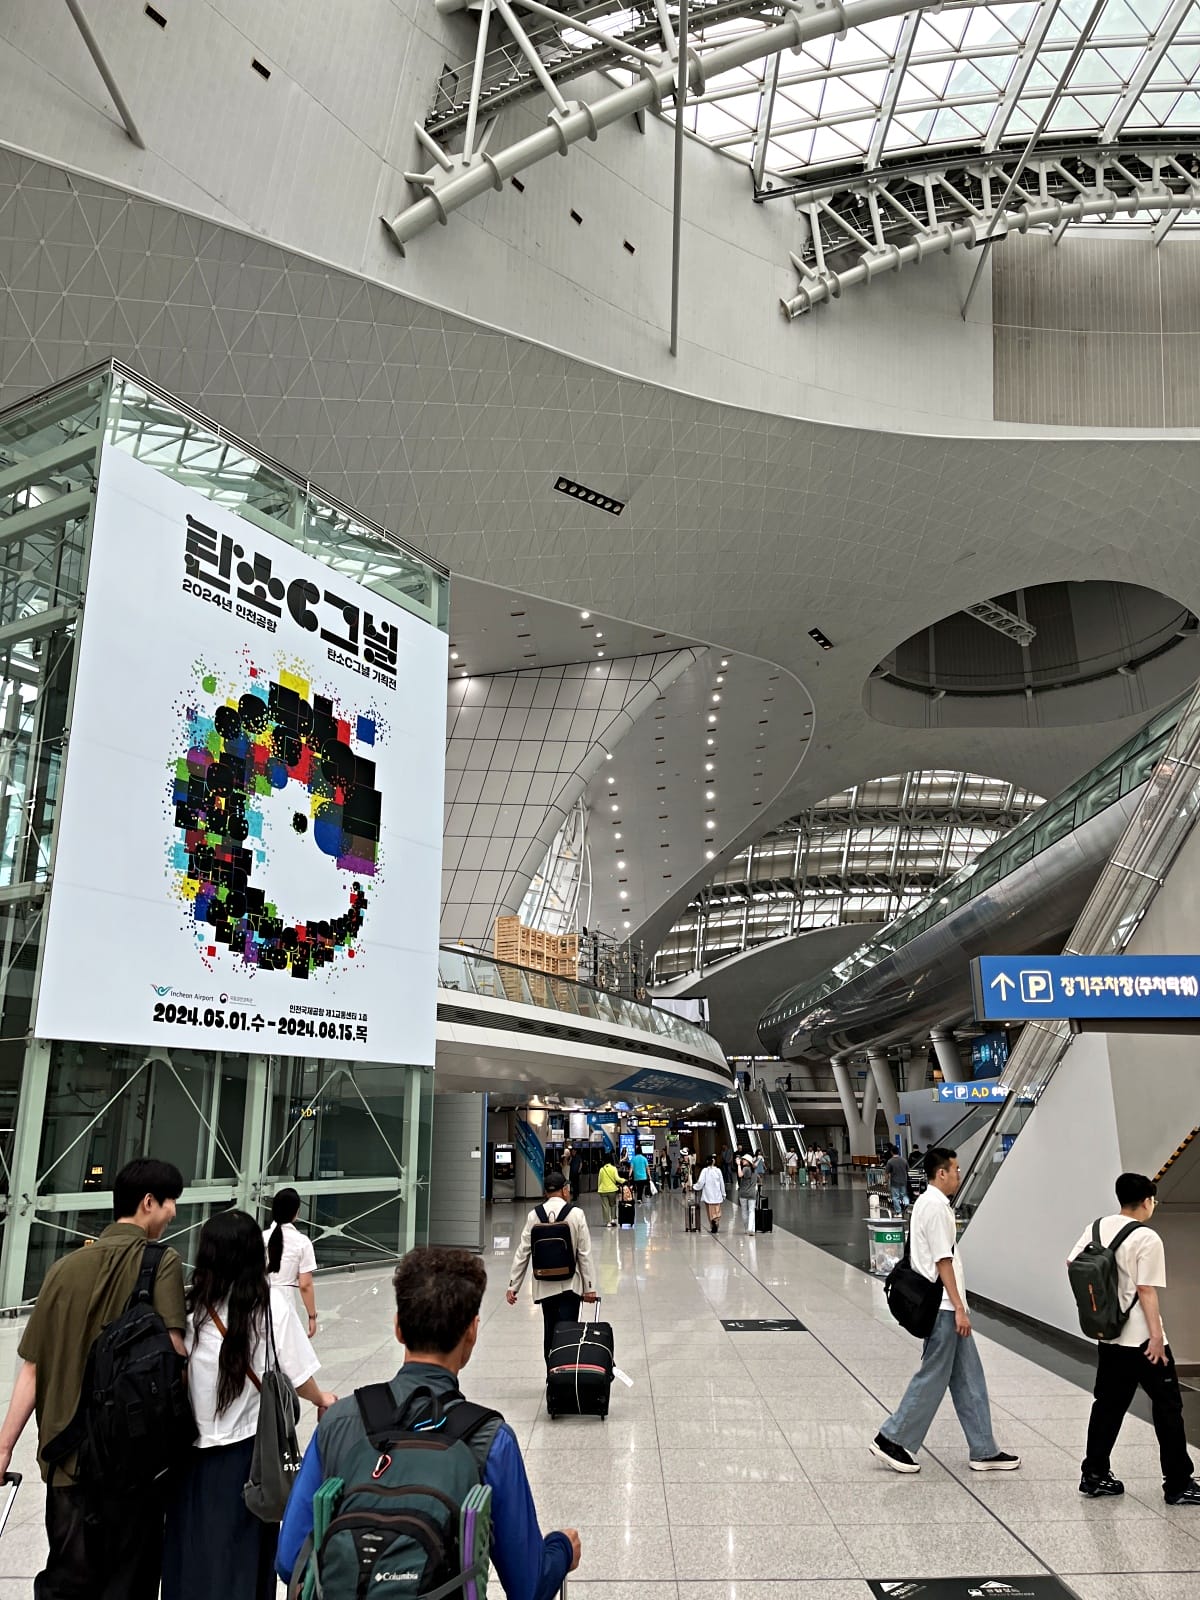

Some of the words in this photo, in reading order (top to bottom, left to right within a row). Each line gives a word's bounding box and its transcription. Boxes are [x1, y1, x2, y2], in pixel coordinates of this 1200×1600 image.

[182, 578, 233, 613] 2024년
[235, 603, 278, 633] 인천공항
[327, 647, 370, 678] 탄소C그널
[372, 669, 397, 691] 기획전
[170, 990, 193, 999] Incheon
[194, 993, 214, 1002] Airport
[1060, 975, 1199, 997] 장기주차장(주차타워)
[382, 1571, 419, 1581] Columbia
